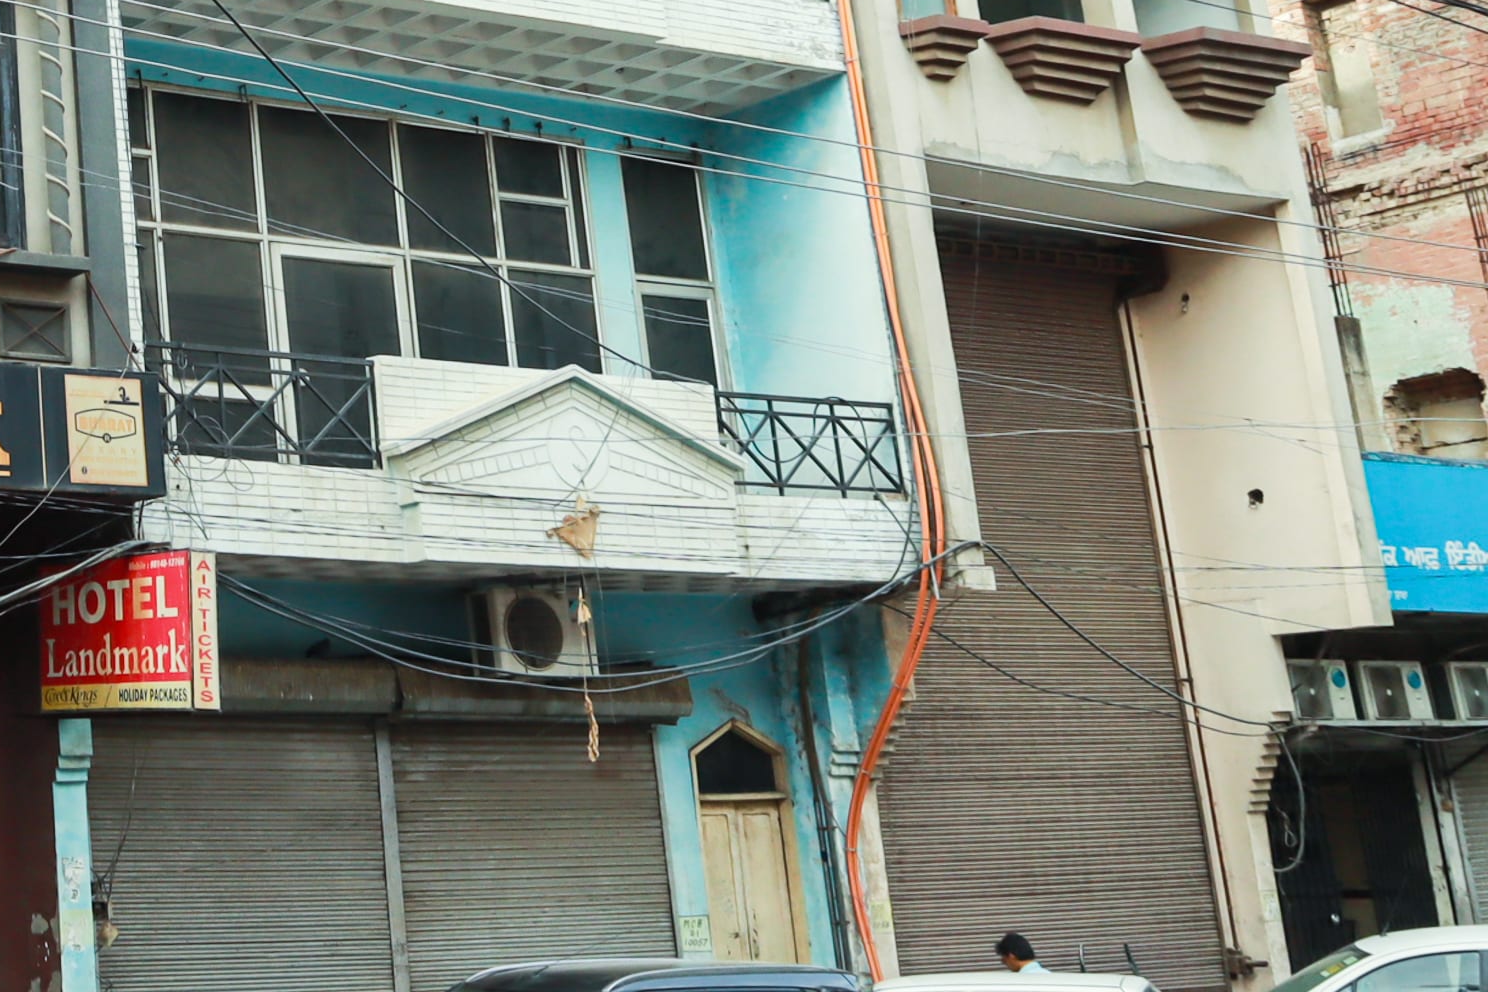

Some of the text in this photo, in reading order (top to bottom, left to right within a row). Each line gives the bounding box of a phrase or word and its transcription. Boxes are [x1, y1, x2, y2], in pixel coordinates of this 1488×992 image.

[52, 575, 179, 626] HOTEL
[46, 628, 188, 678] Landmark
[196, 559, 214, 703] AIR TICKETS
[118, 688, 148, 702] HOLIDAY
[149, 688, 188, 702] PACKAGES
